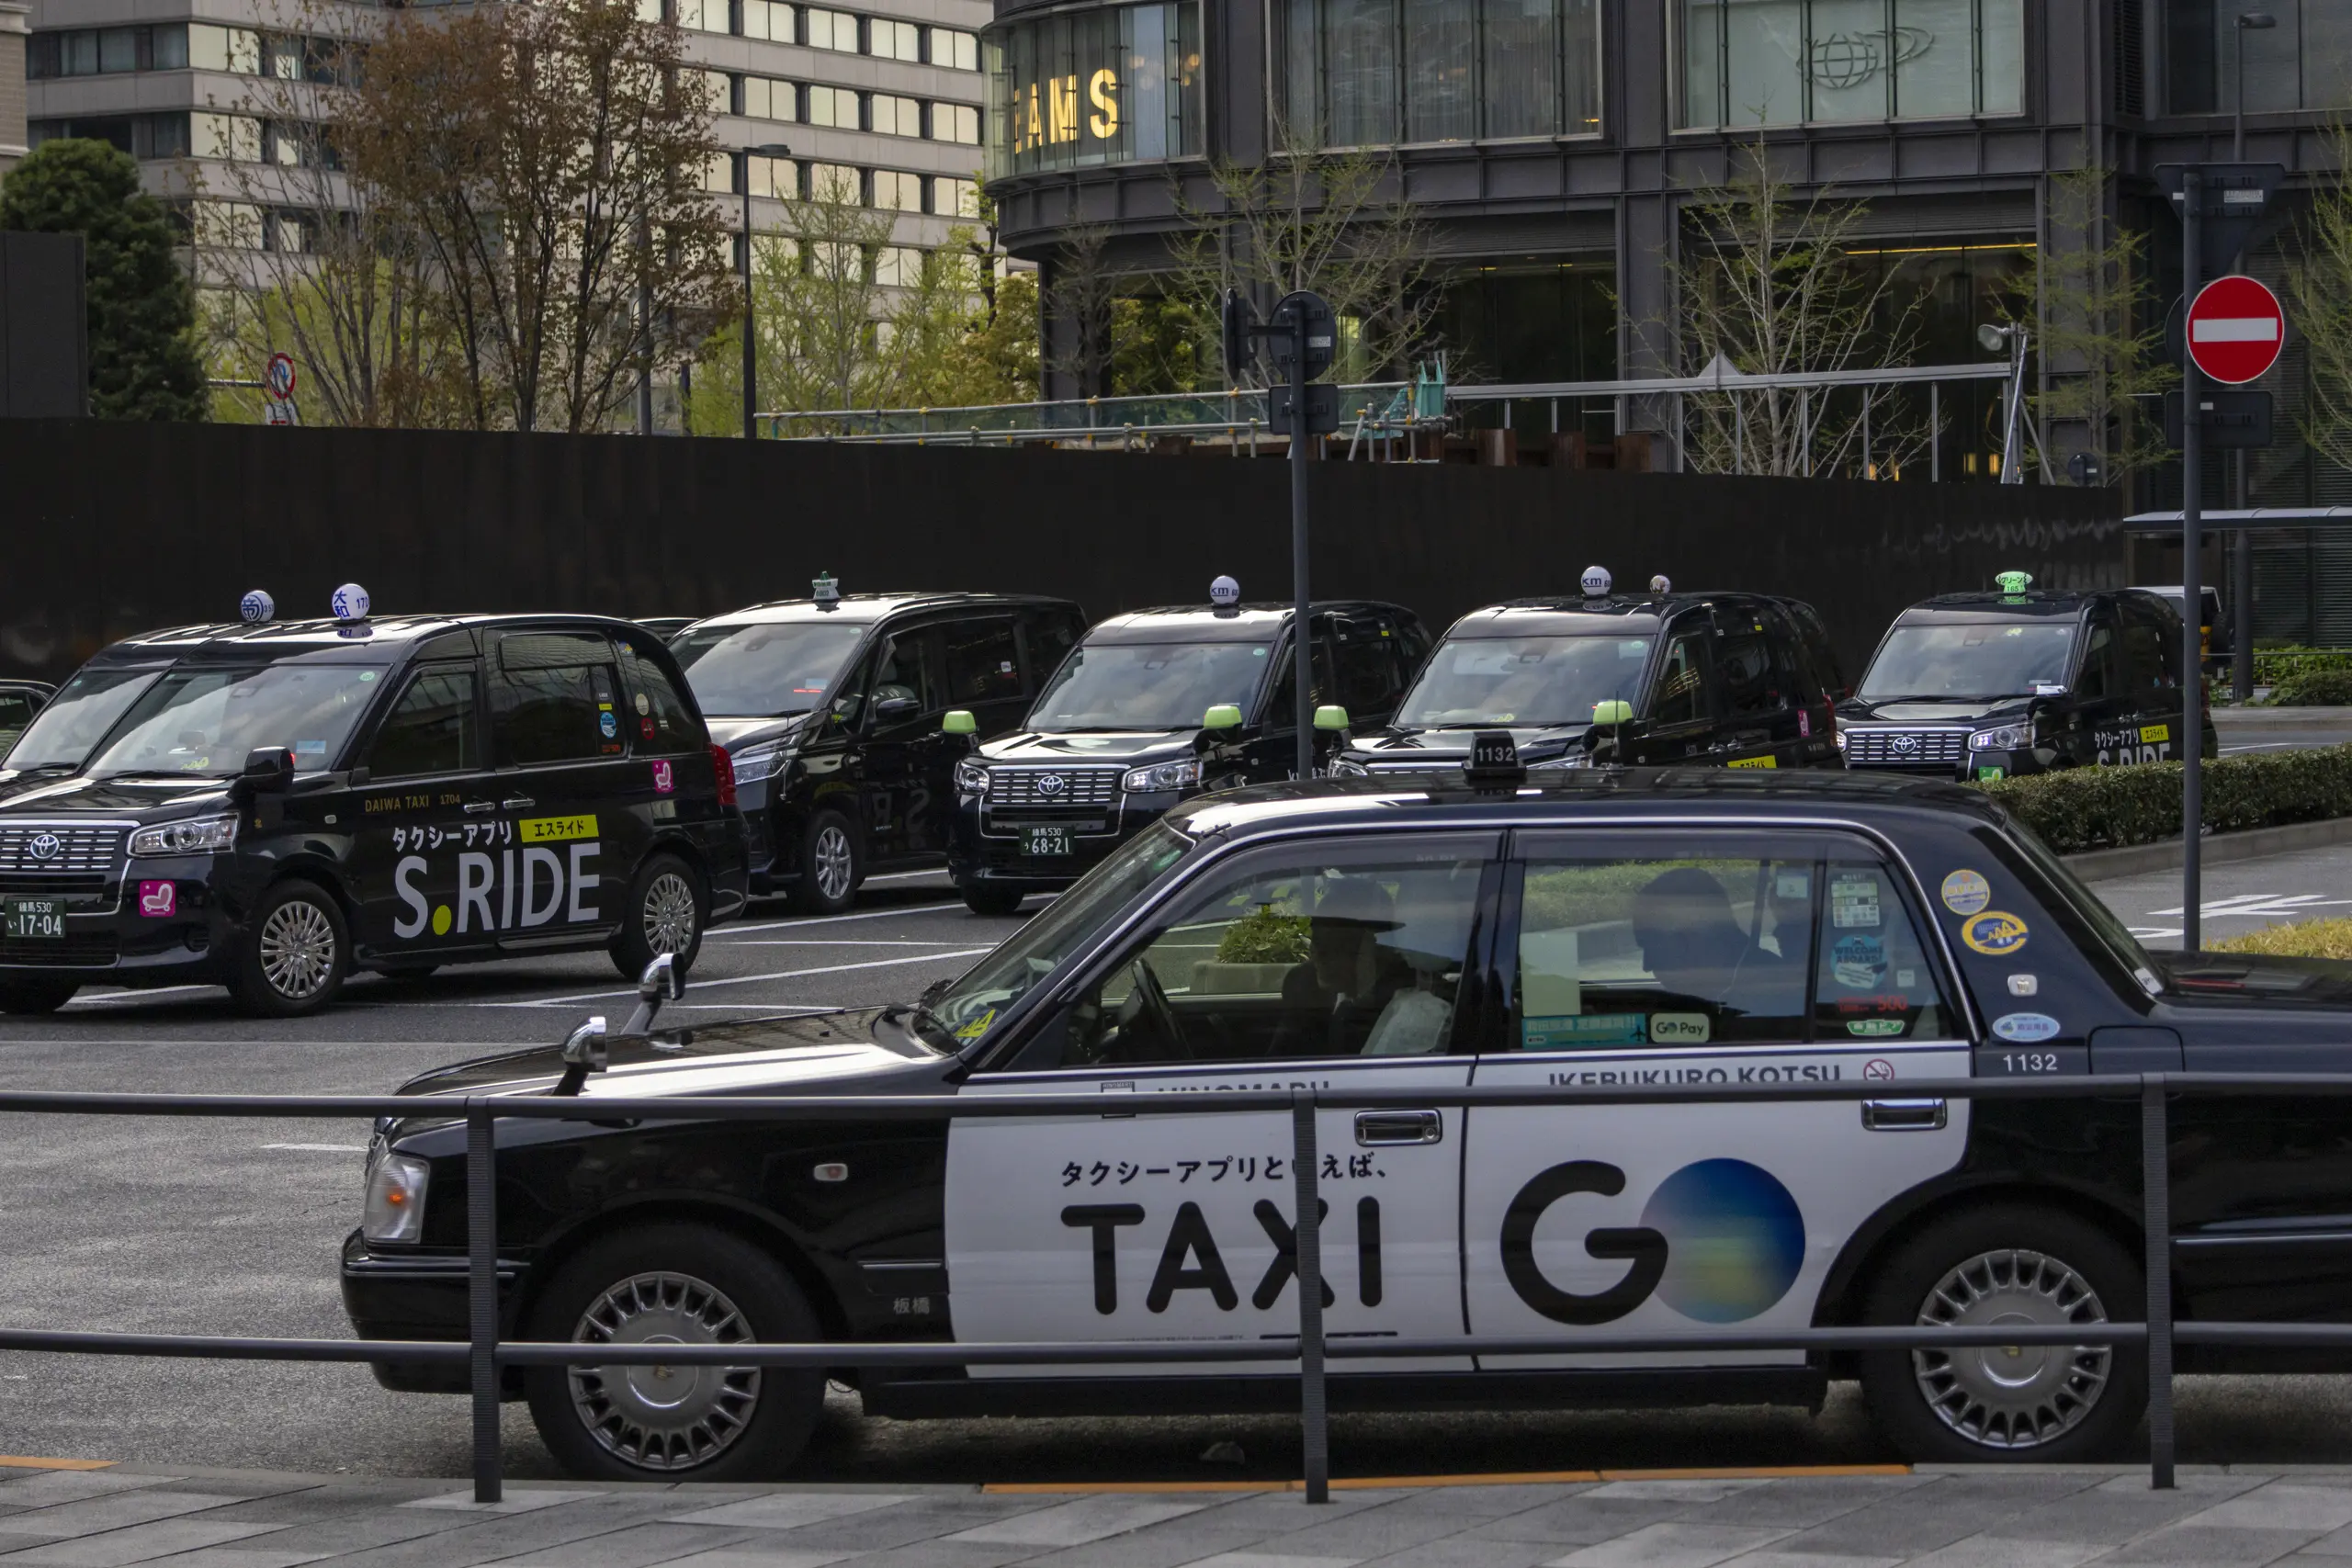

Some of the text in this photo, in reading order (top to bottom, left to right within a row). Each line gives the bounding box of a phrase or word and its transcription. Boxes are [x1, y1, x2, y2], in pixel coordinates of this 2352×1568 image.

[2001, 576, 2023, 584] グリーン
[333, 591, 351, 618] 大和
[2094, 728, 2140, 750] タクシーアプリ
[1476, 746, 1514, 762] 1132
[365, 794, 461, 813] DAIWA TAXI 1704
[392, 818, 584, 852] タクシーアプリ エスライド
[1031, 837, 1069, 854] 68-21
[393, 842, 601, 939] S.RIDE
[7, 914, 62, 935] い 17-04
[1834, 946, 1883, 955] WELCOME
[1877, 995, 1908, 1011] 500
[1679, 1022, 1704, 1036] Pay
[2003, 1053, 2058, 1073] 1132
[1061, 1152, 1387, 1187] タクシーアプリとえば、
[1060, 1195, 1383, 1315] TAXI
